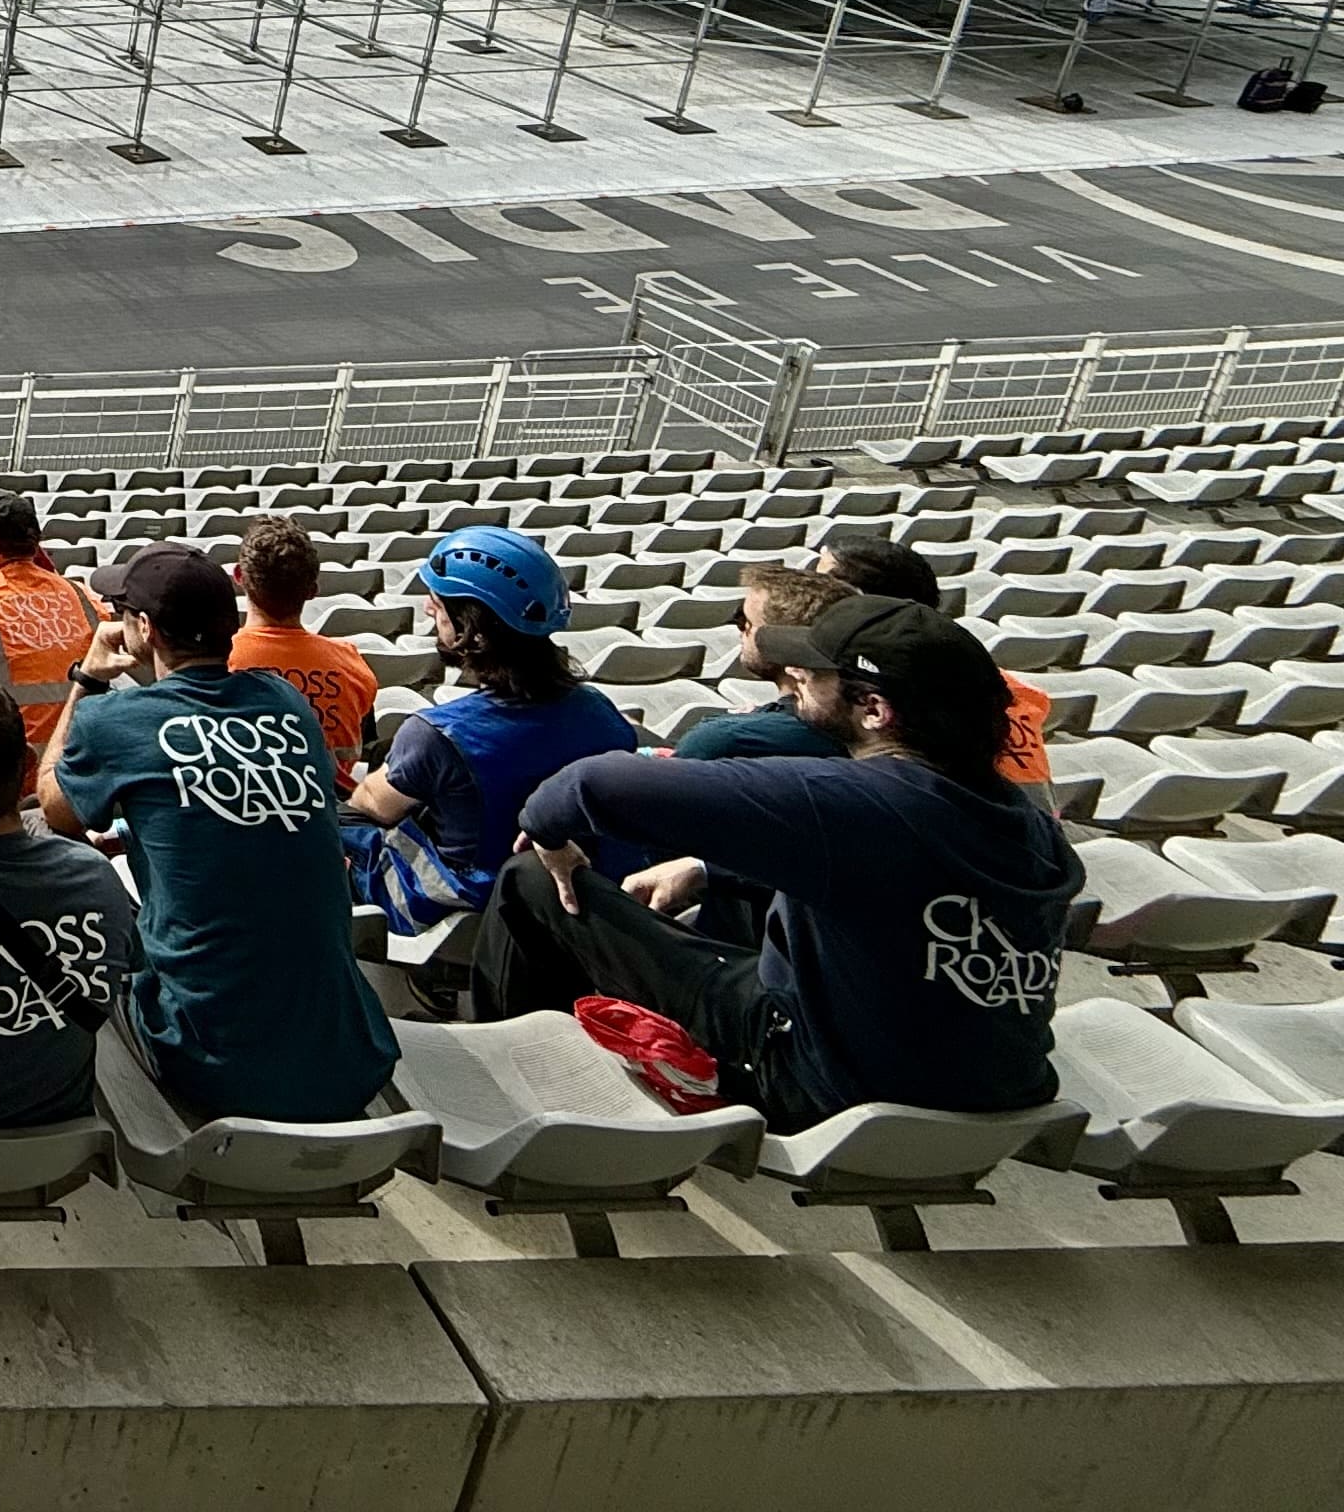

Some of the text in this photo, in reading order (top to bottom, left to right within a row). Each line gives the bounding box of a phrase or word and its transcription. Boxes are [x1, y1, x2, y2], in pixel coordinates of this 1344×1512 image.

[7, 616, 85, 651] ROADS
[158, 713, 309, 770] CROSS
[172, 764, 326, 833] ROADS
